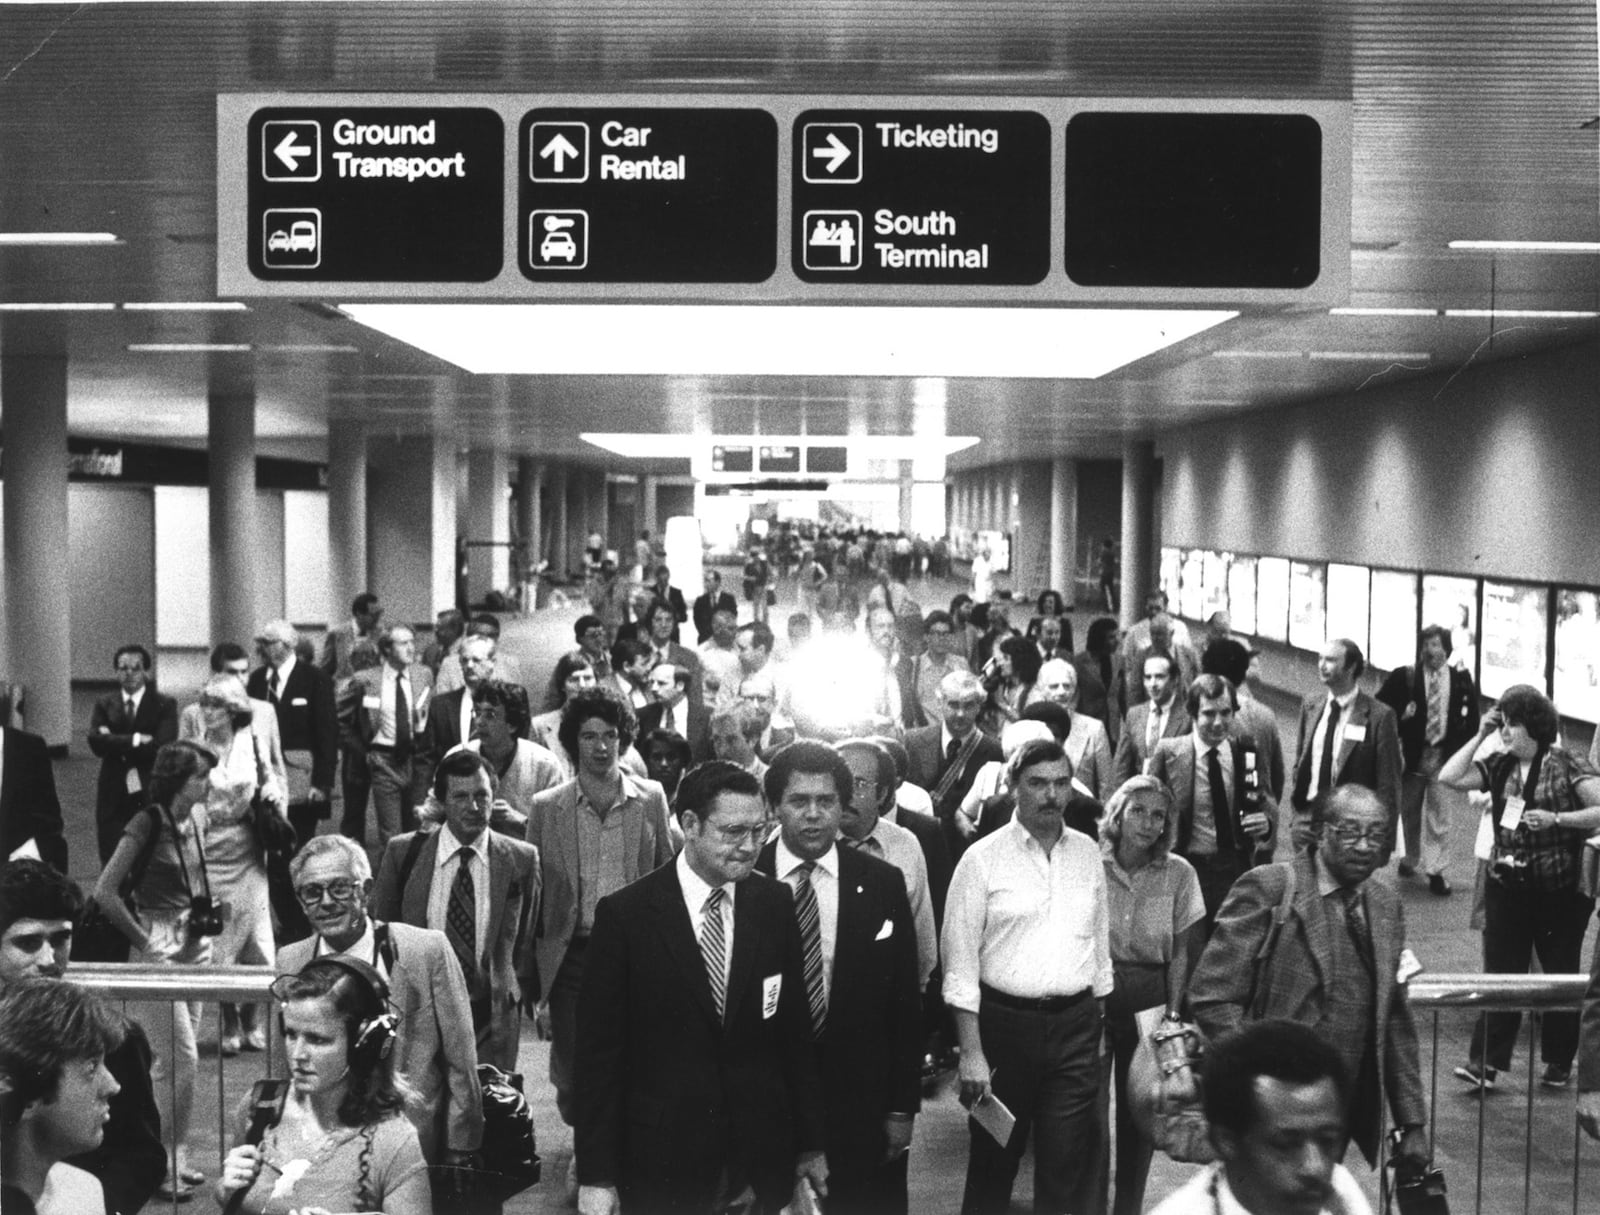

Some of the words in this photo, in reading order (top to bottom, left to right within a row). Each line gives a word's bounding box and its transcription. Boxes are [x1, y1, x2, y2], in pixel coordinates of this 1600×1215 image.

[332, 118, 436, 146] Ground
[600, 120, 652, 148] Car
[875, 122, 999, 154] Ticketing
[332, 151, 466, 183] Transport
[600, 154, 686, 181] Rental
[873, 208, 956, 236] South
[873, 242, 989, 269] Terminal
